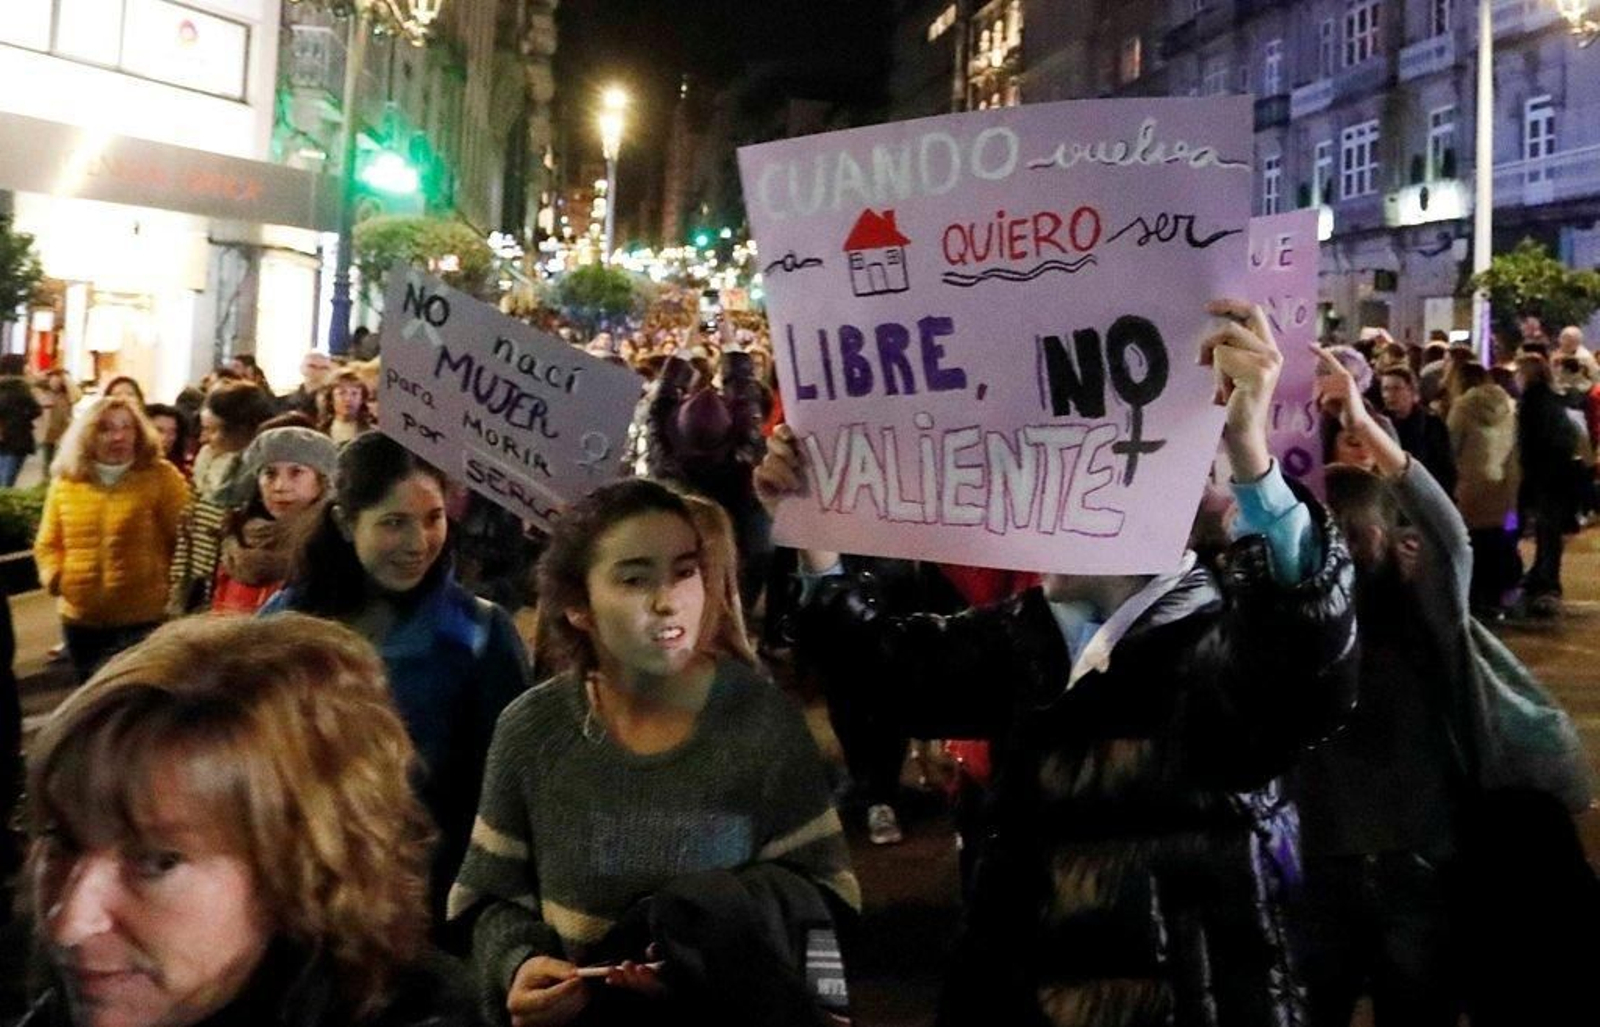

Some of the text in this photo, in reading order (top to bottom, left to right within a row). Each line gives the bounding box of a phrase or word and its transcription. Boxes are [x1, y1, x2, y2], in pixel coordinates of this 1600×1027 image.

[757, 119, 1248, 220] CUANDO vuelva
[766, 252, 823, 275] a
[1107, 211, 1243, 249] ser
[403, 282, 588, 393] NO nací
[787, 315, 988, 401] LIBRE,
[1037, 314, 1170, 419] NO
[386, 367, 552, 477] para MORIR
[401, 411, 446, 445] por
[433, 344, 559, 439] MUJER
